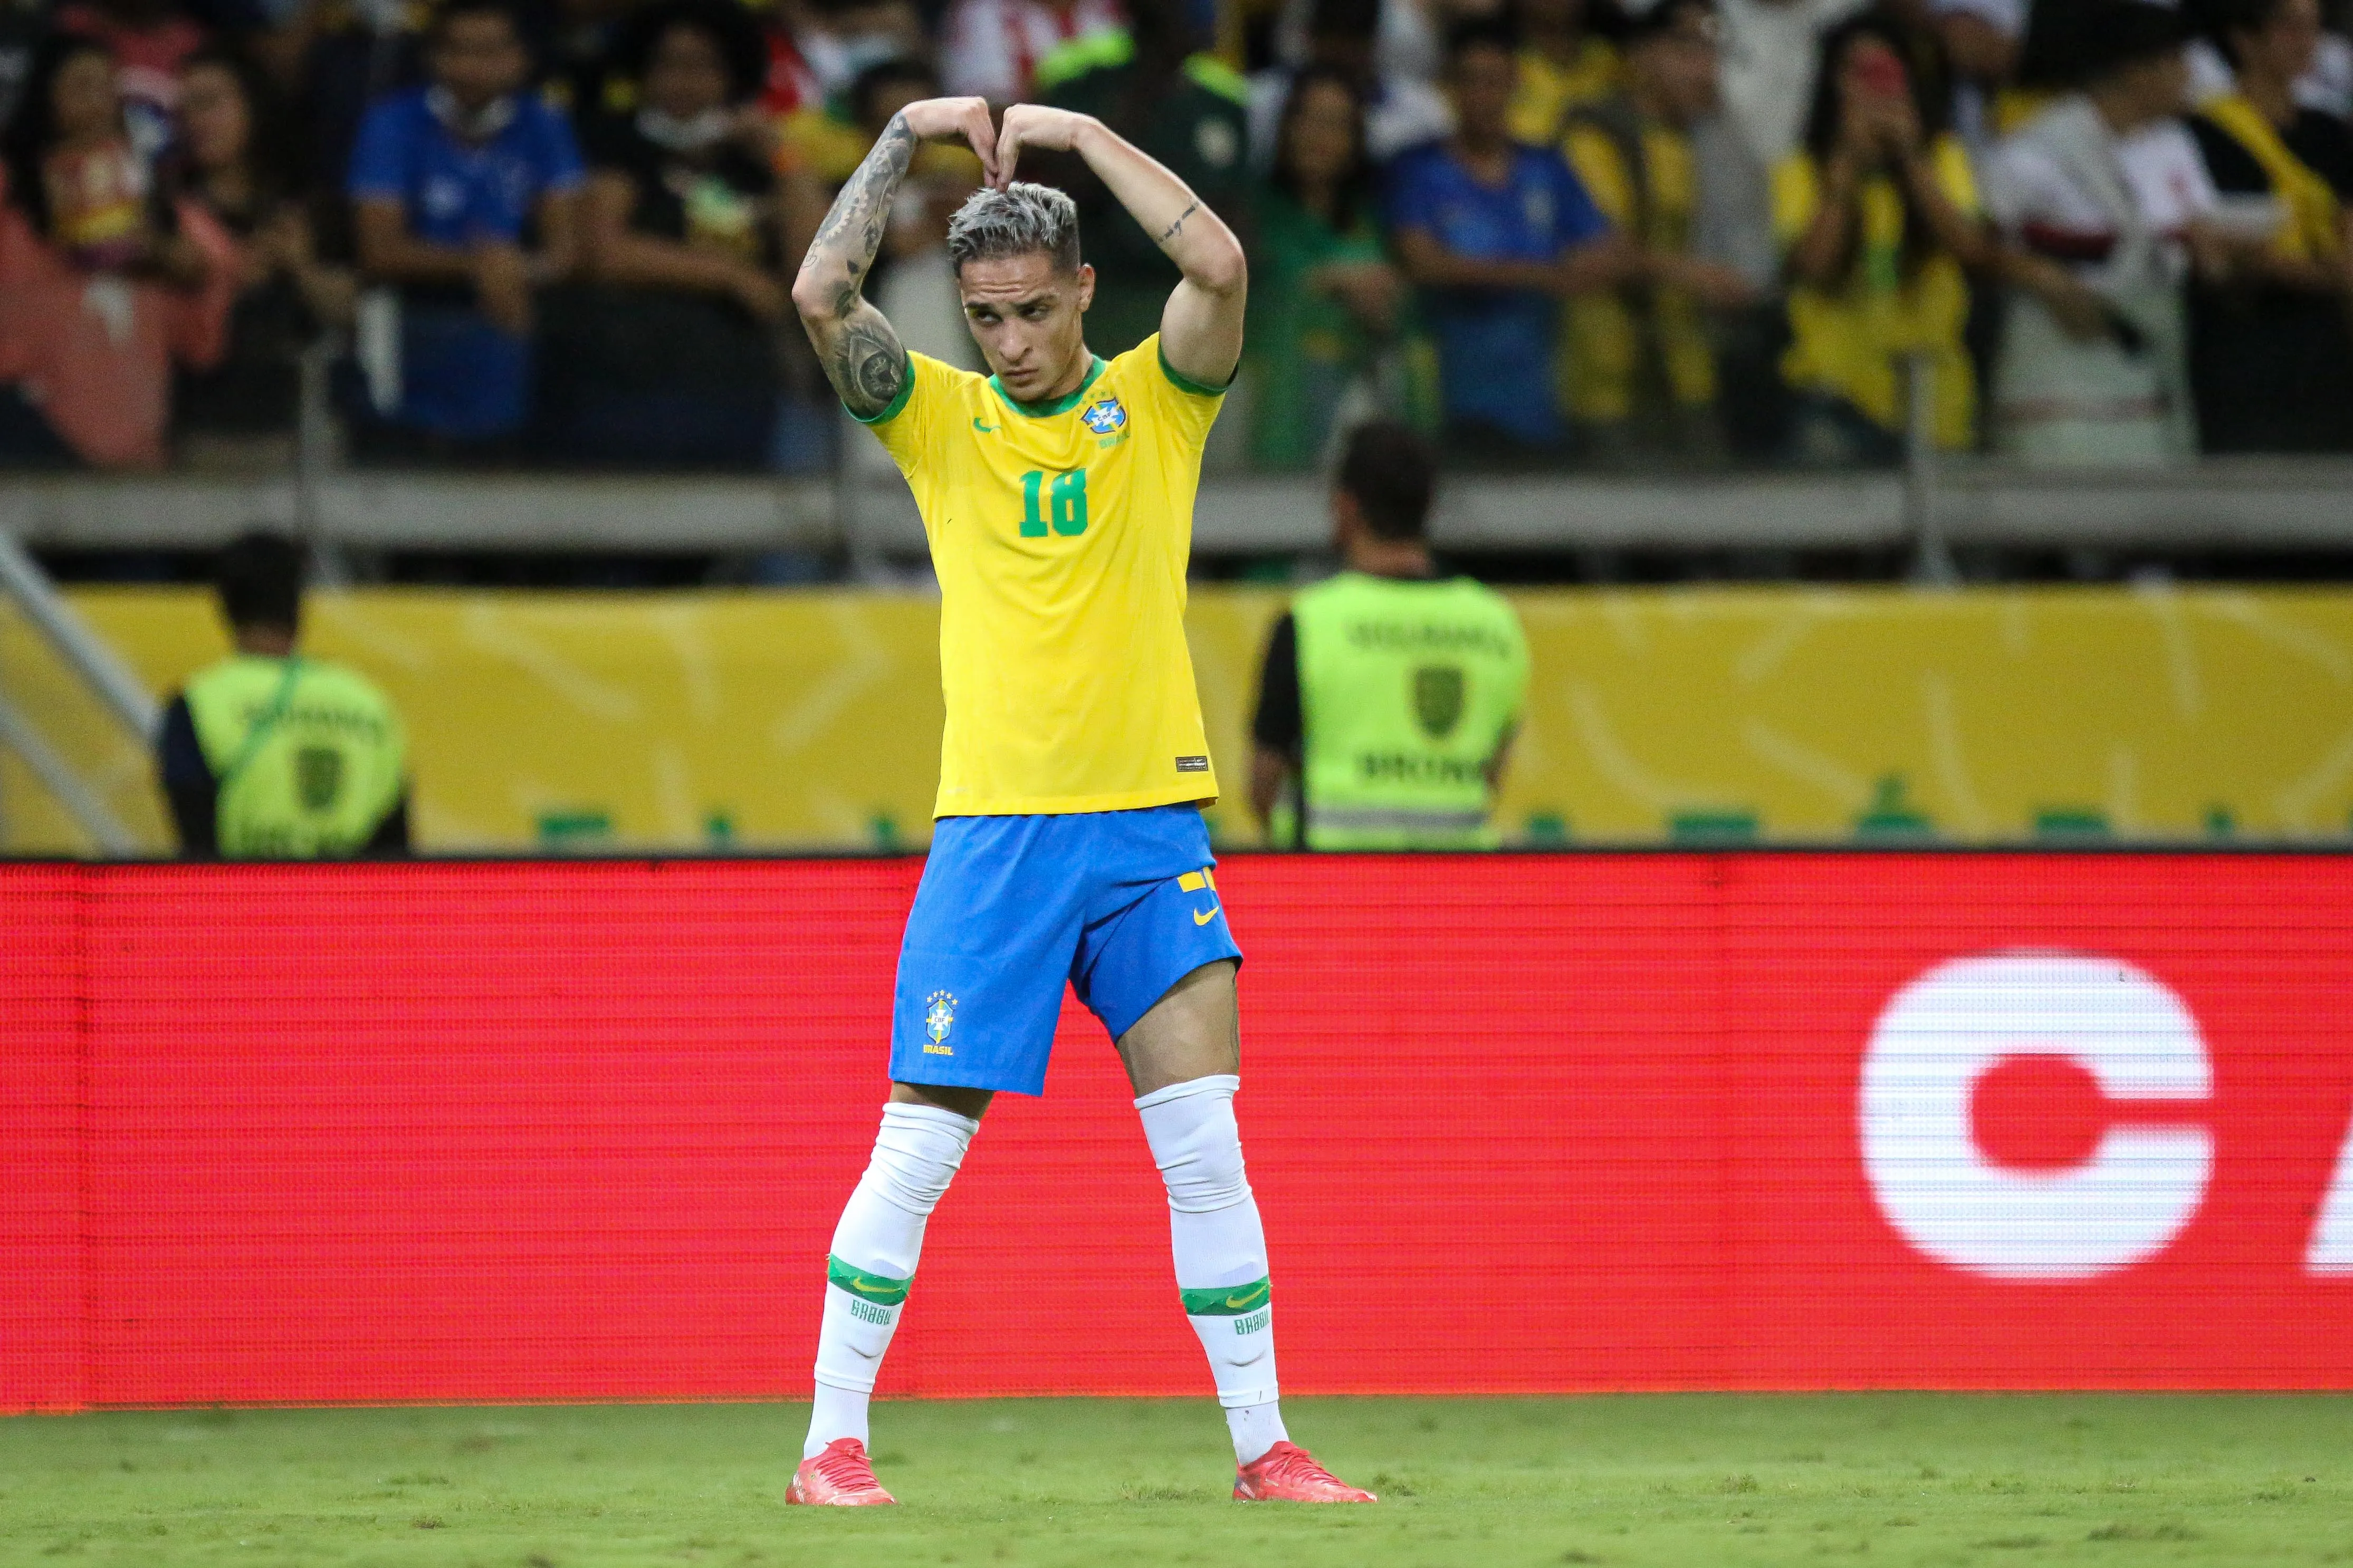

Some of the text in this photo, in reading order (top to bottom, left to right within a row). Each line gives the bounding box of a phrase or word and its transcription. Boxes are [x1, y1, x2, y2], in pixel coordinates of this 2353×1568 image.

[1019, 468, 1088, 537] 18
[923, 1044, 954, 1056] BRASIL
[1856, 948, 2353, 1280] C
